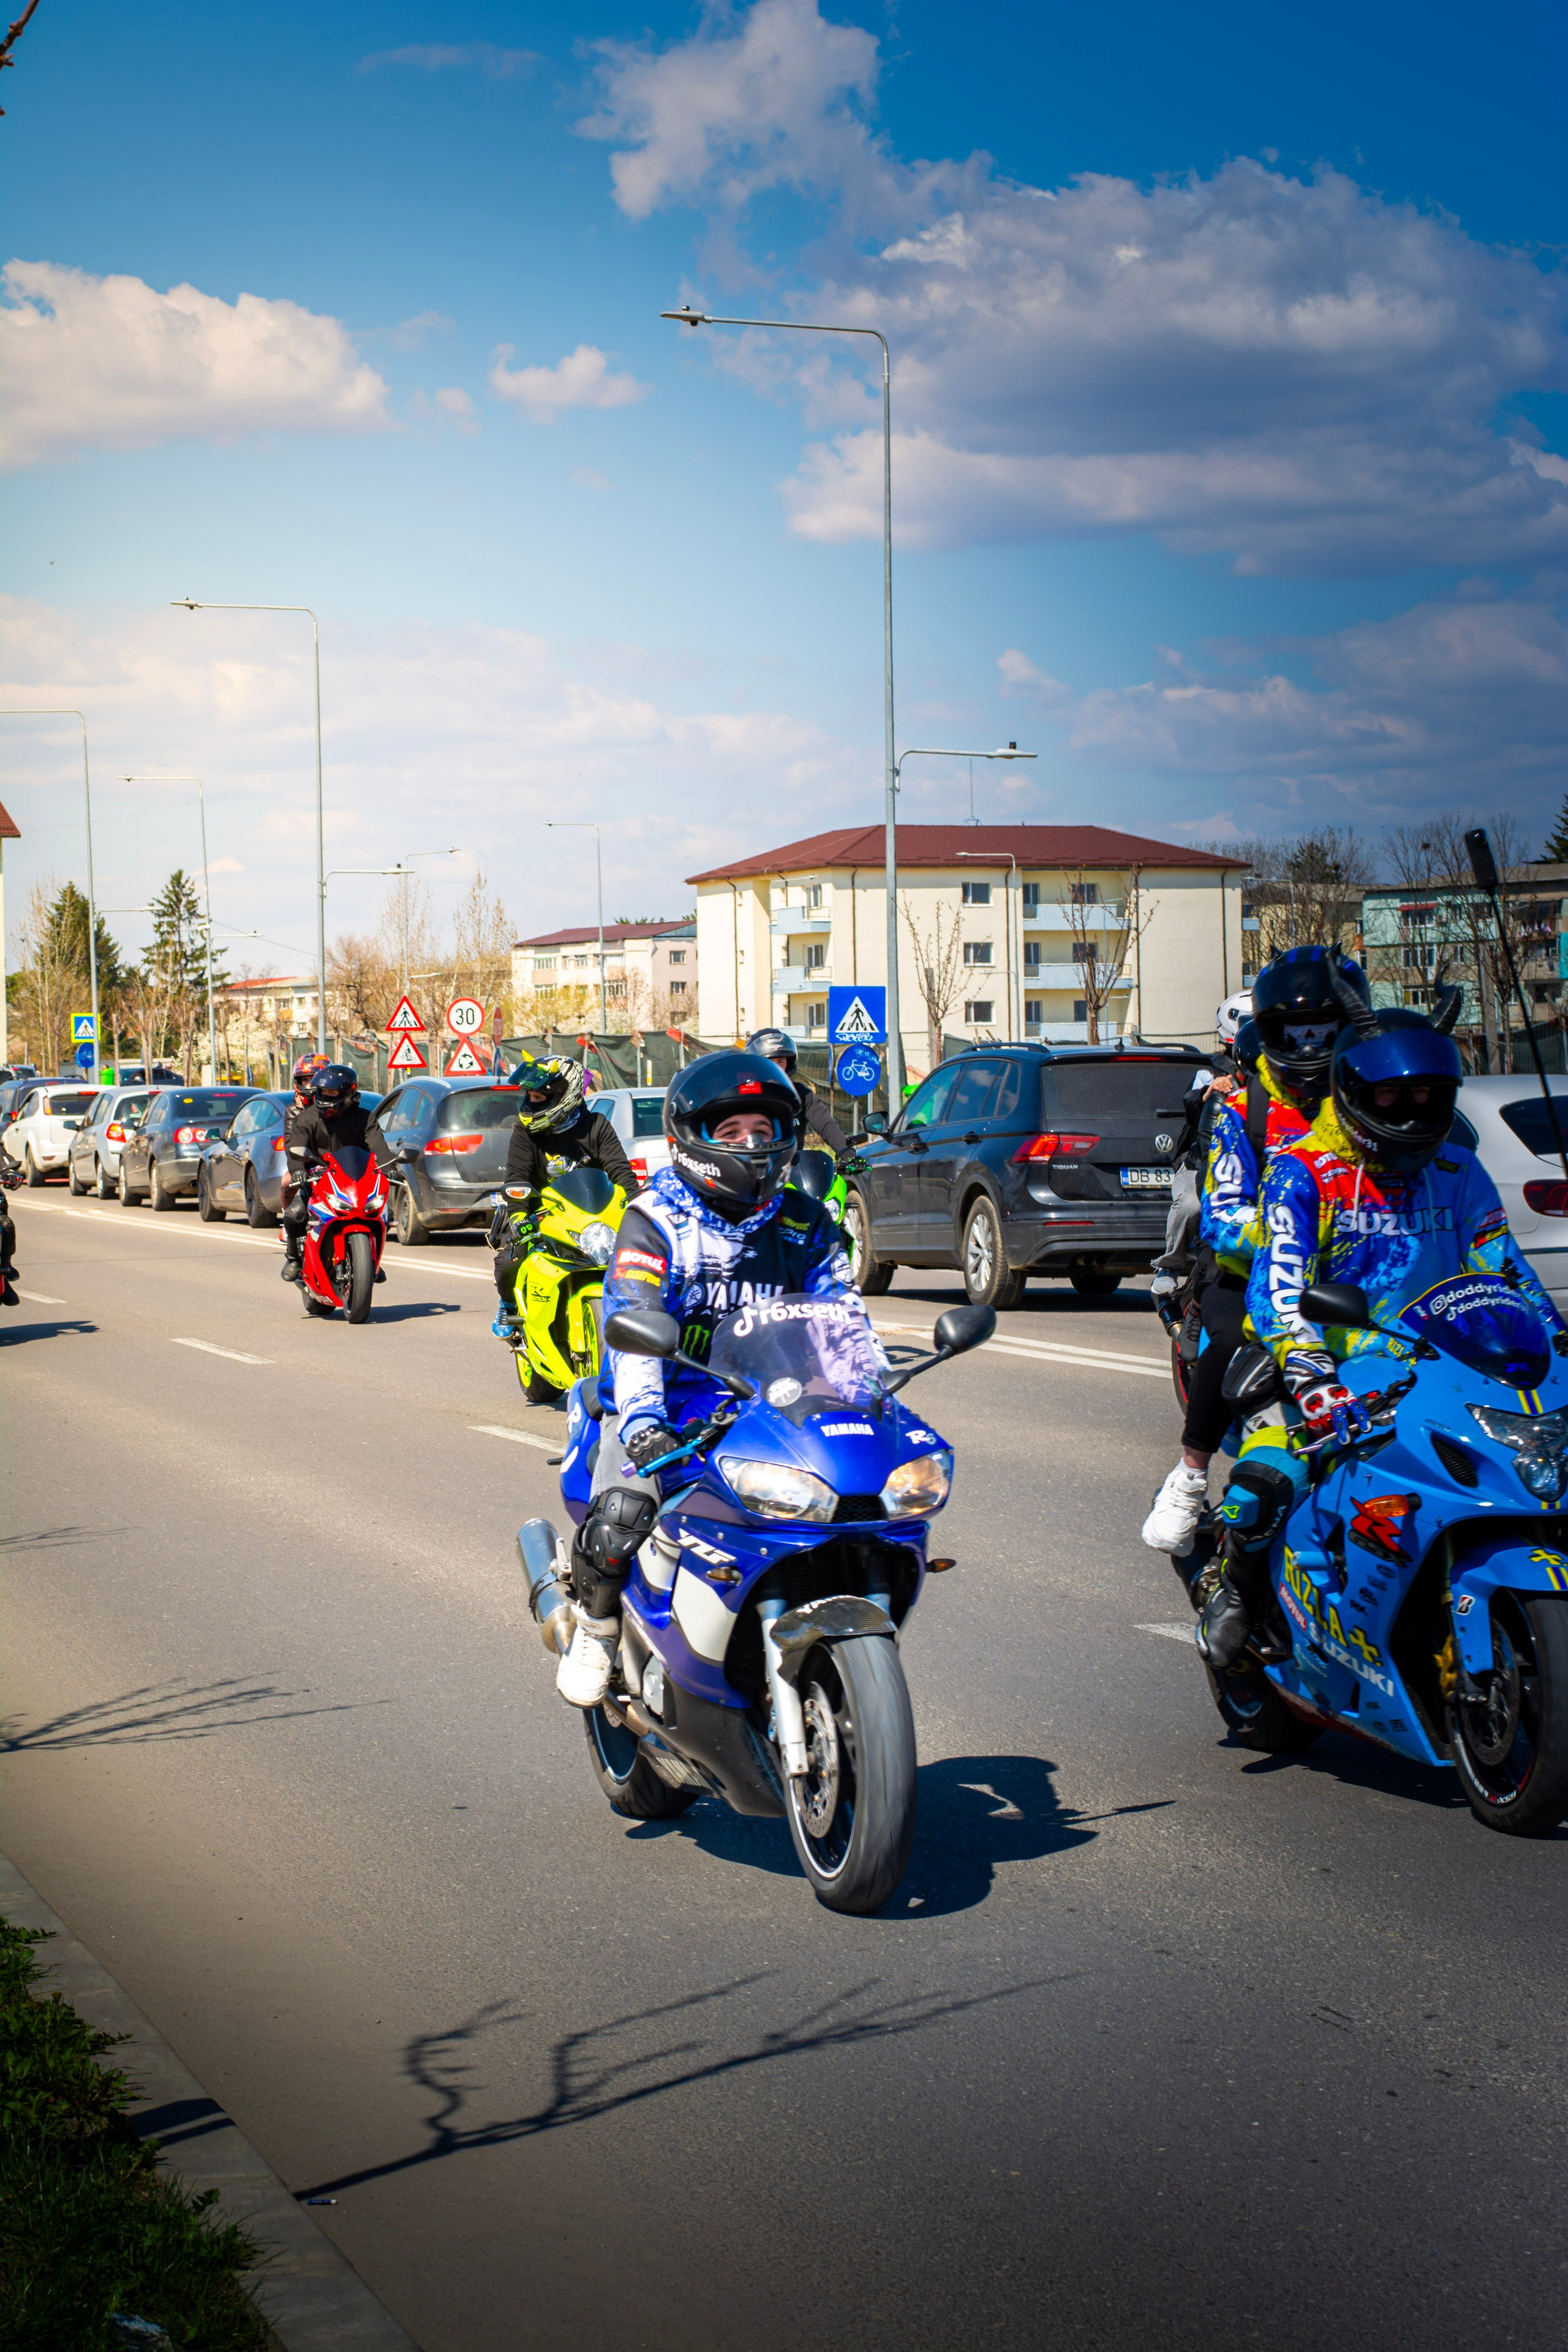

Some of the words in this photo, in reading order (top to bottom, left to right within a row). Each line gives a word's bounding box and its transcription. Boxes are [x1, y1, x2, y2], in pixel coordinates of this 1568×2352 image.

[456, 1008, 475, 1025] 30
[1129, 1169, 1150, 1183] DB
[1155, 1169, 1170, 1183] 83
[1337, 1207, 1453, 1236] SUZUKI
[779, 1227, 807, 1240] Pro
[618, 1251, 663, 1271] MOTUL
[1267, 1203, 1325, 1345] SUZUK
[684, 1309, 729, 1319] RAC
[759, 1301, 851, 1325] r6xseth
[820, 1423, 875, 1437] YAMAHA
[905, 1430, 937, 1445] R6
[1280, 1583, 1306, 1631] MOTUL
[1309, 1621, 1394, 1698] SUZUKI
